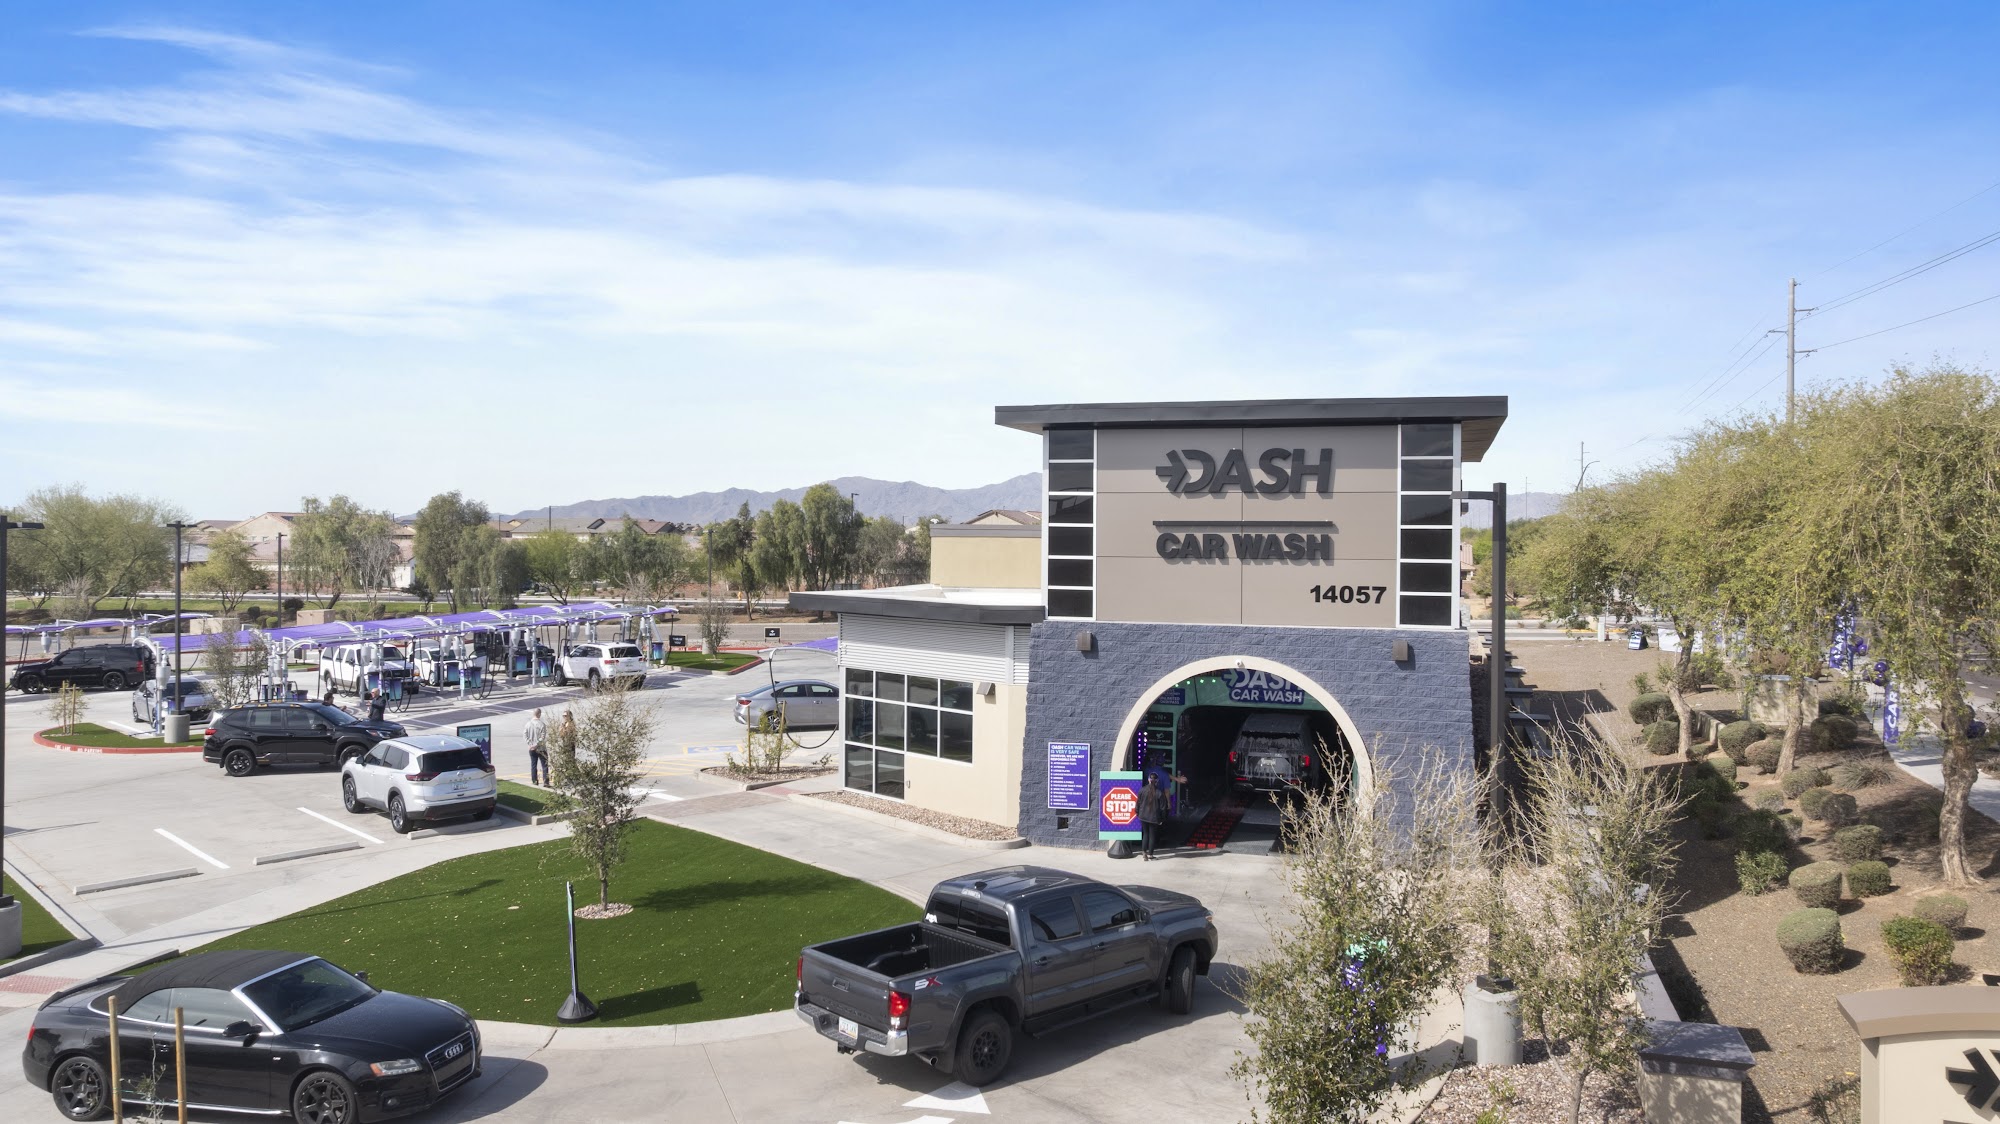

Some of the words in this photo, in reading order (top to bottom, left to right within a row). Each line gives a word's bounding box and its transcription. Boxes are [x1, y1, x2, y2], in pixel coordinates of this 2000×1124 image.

[1181, 448, 1333, 493] DASH
[1156, 533, 1227, 560] CAR
[1232, 533, 1331, 561] WASH
[1310, 585, 1387, 604] 14057
[1231, 689, 1259, 701] CAR
[1263, 690, 1302, 703] WASH
[1888, 691, 1898, 729] CAR
[1106, 801, 1137, 812] STOP
